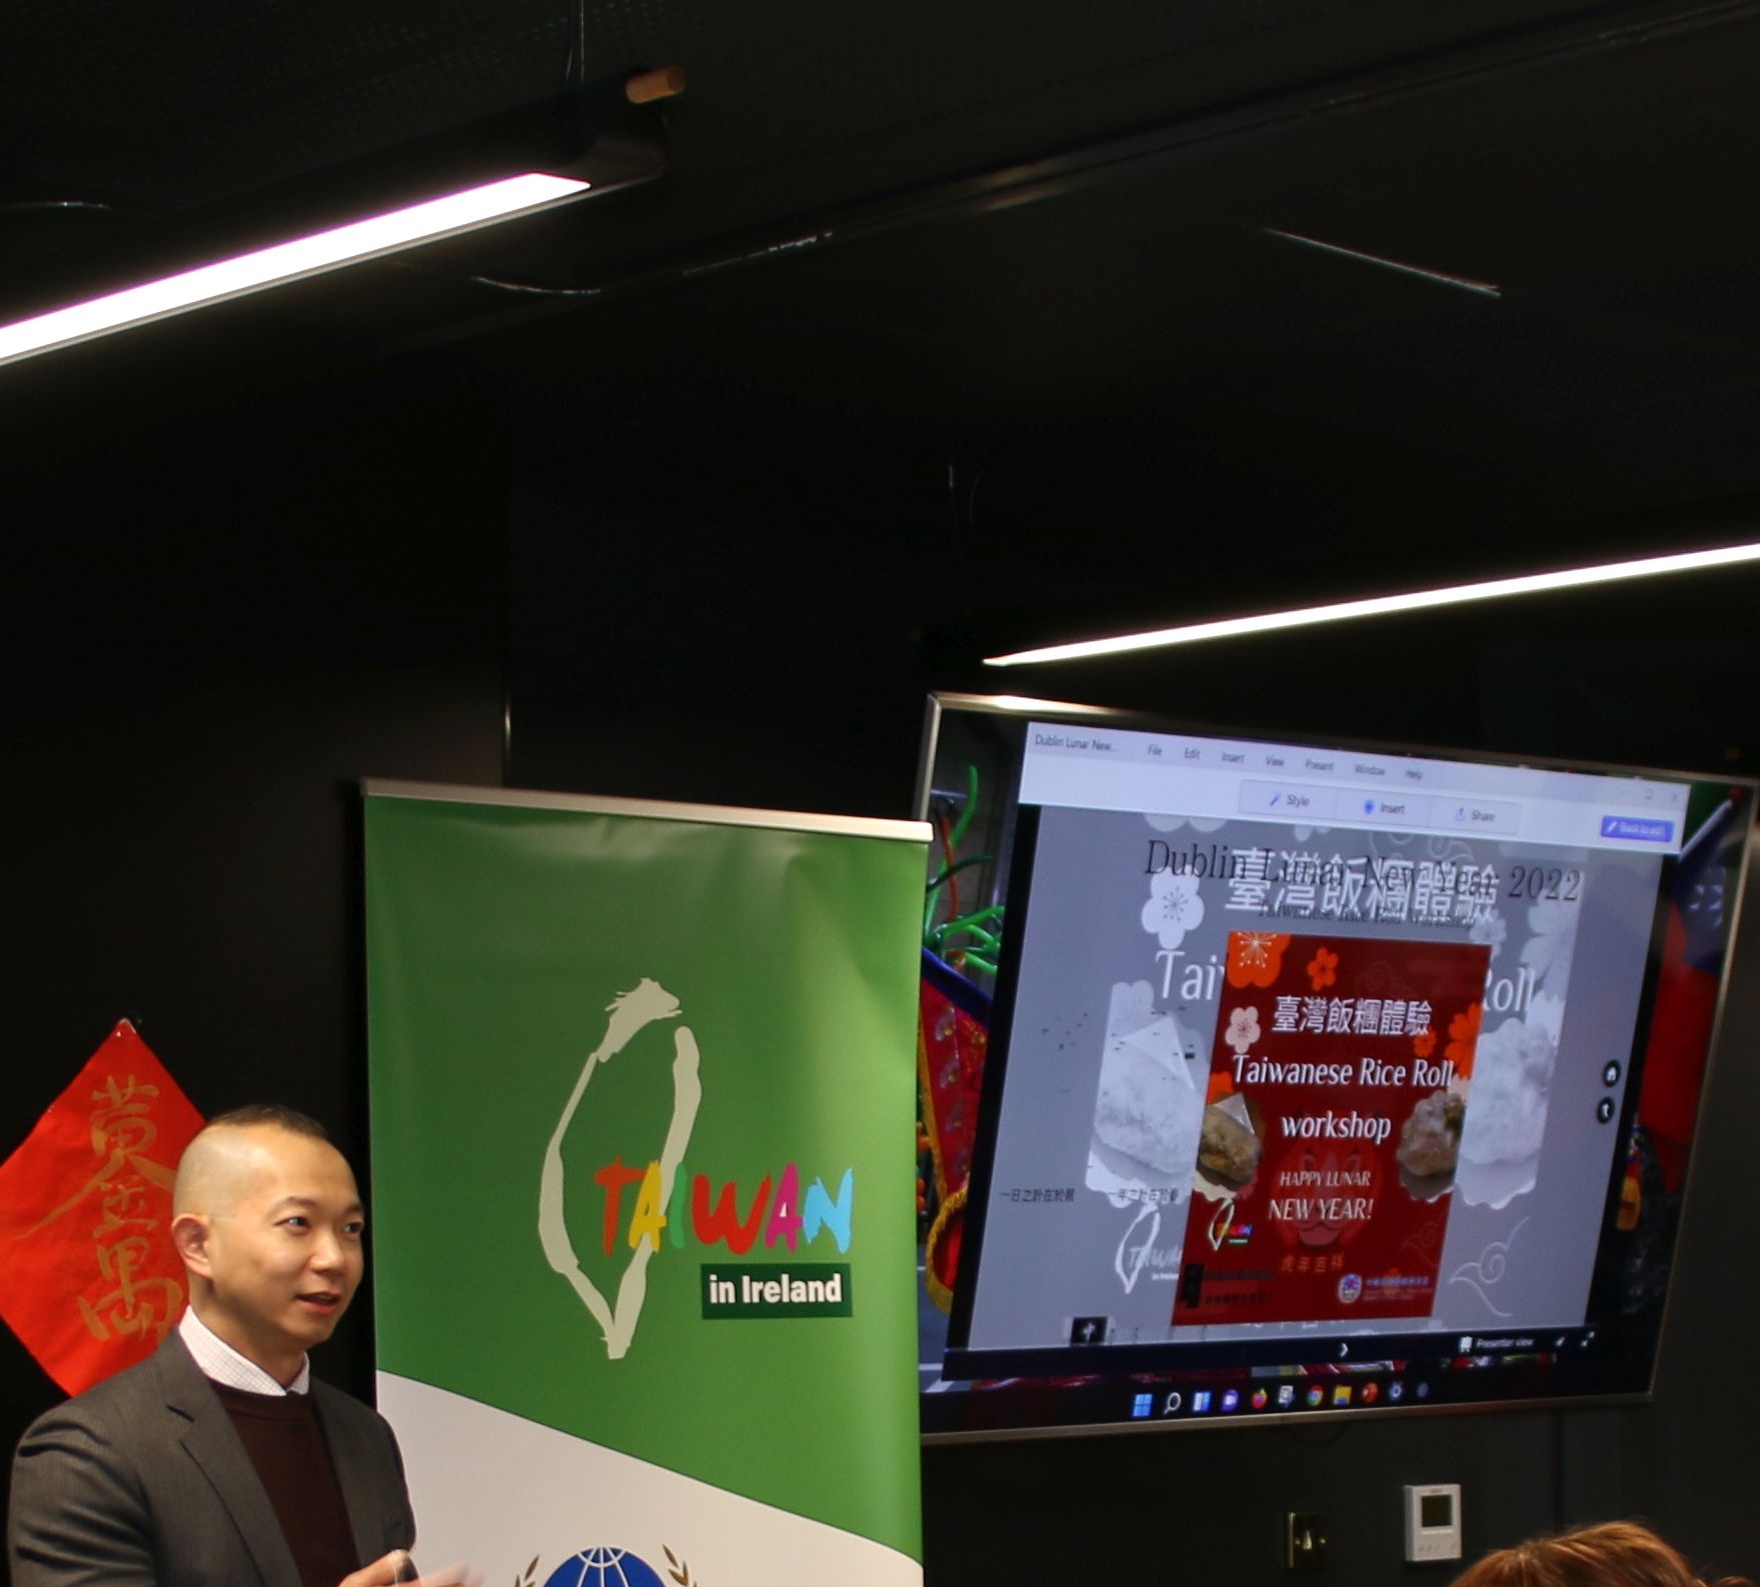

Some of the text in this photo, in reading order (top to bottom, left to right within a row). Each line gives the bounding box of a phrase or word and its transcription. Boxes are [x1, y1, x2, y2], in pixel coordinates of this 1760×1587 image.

[1287, 794, 1310, 807] Style
[1380, 803, 1405, 815] Insert
[1144, 840, 1247, 882] Dublin
[1360, 855, 1417, 893] New
[1508, 865, 1582, 902] 2022
[1233, 1055, 1454, 1087] Taiwanese Rice Roll
[1282, 1110, 1391, 1145] workshop
[1280, 1171, 1371, 1187] HAPPY LUNAR
[594, 1157, 853, 1257] TAIWAN
[1268, 1199, 1374, 1220] NEW YEAR!
[709, 1272, 842, 1305] in Ireland
